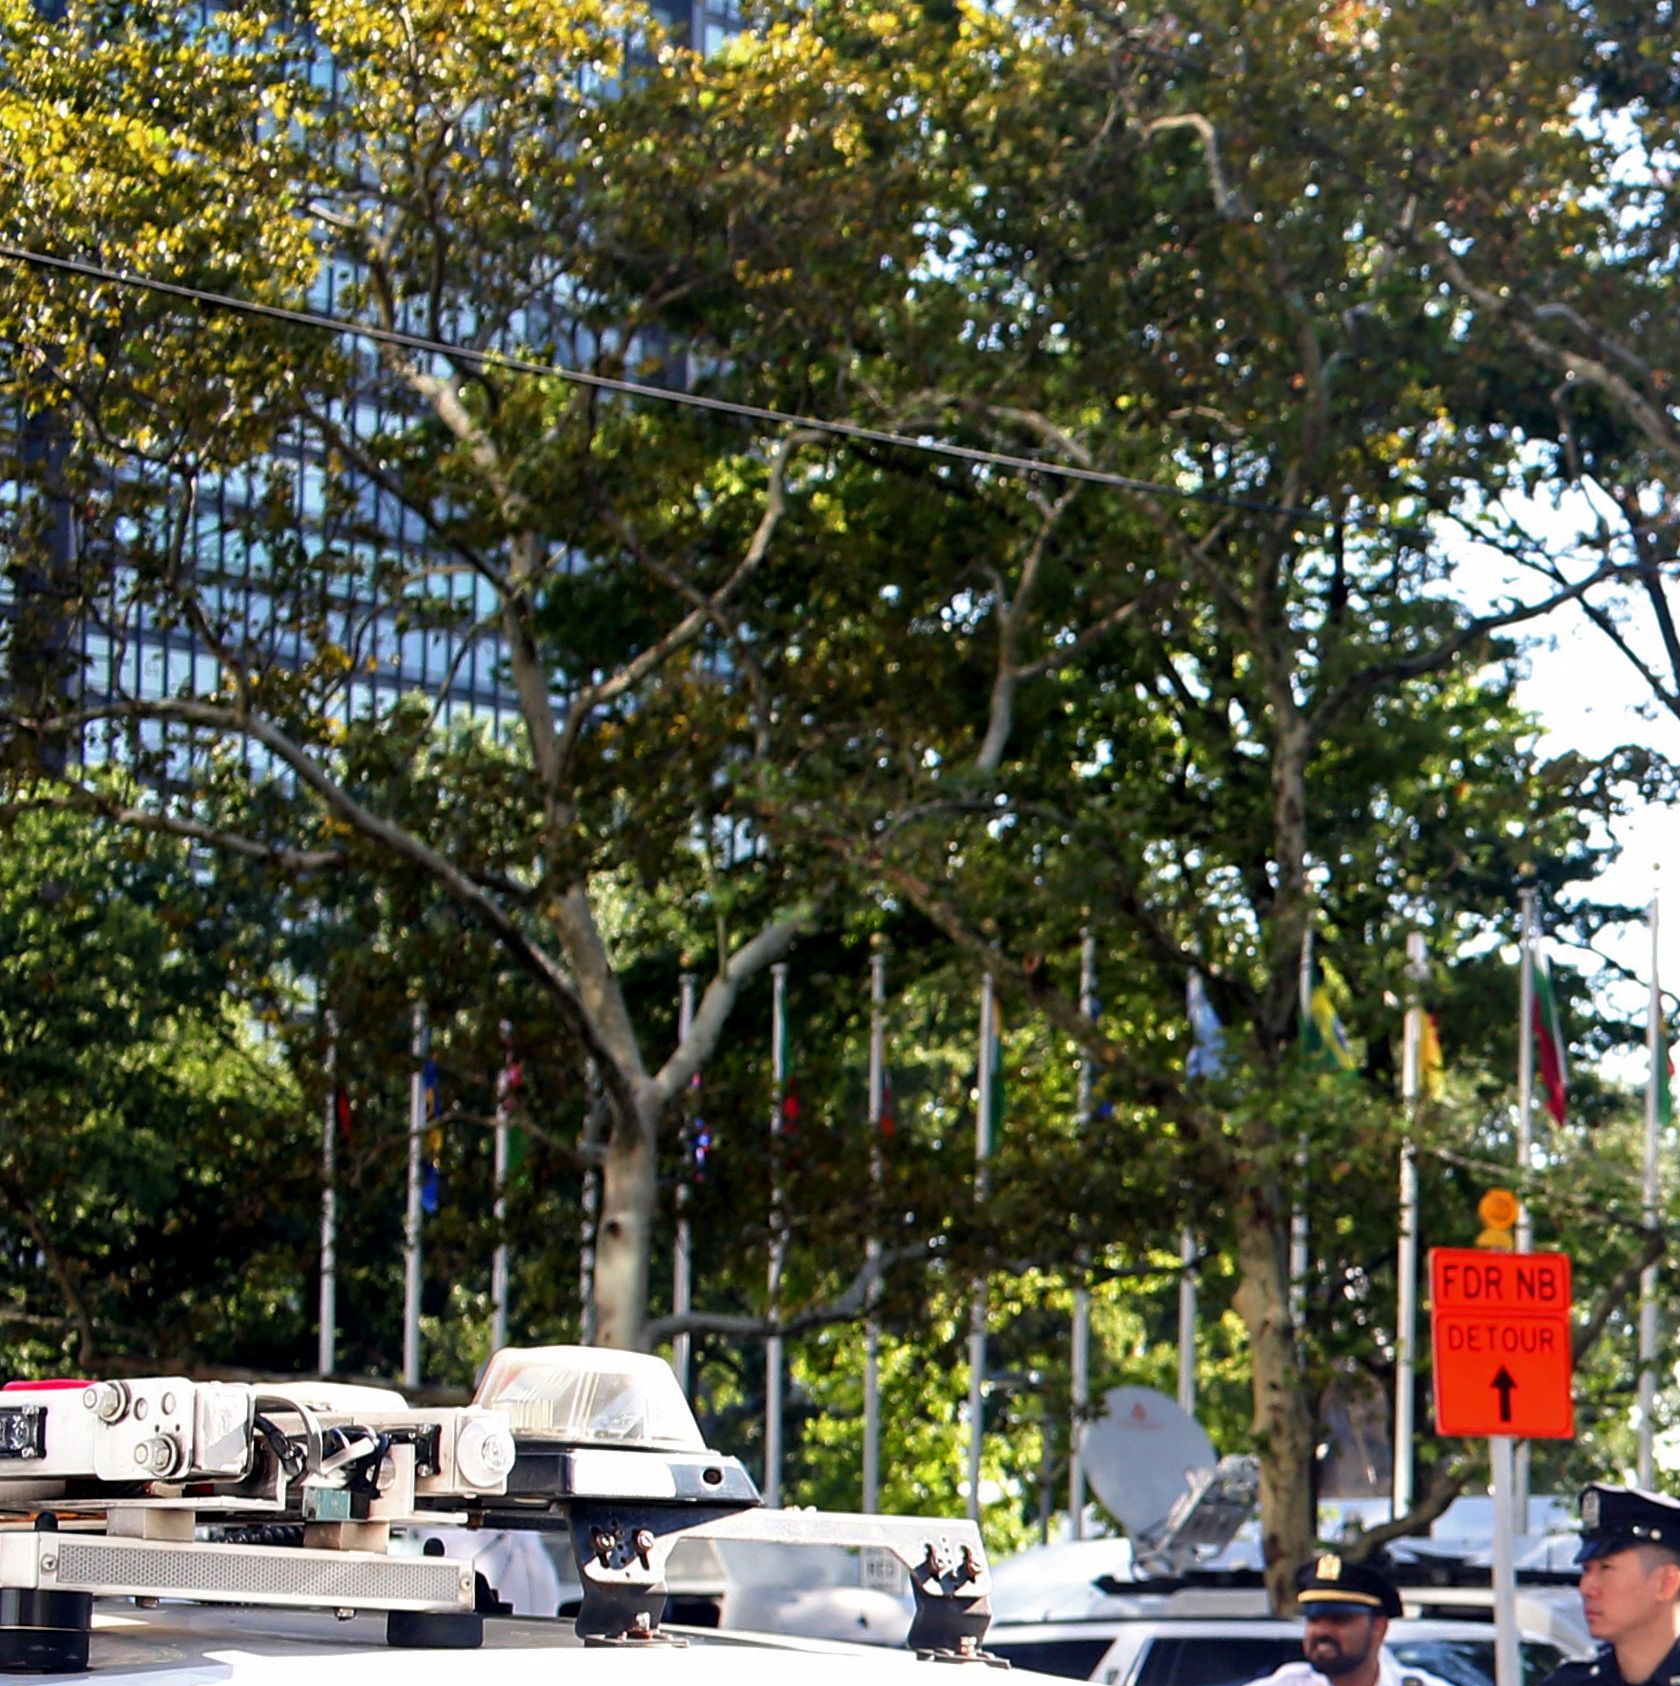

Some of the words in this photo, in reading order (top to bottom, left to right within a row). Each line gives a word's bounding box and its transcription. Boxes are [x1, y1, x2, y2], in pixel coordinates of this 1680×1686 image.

[1443, 1265, 1503, 1299] FDR
[1516, 1267, 1556, 1301] NB
[1448, 1324, 1555, 1353] DETOUR
